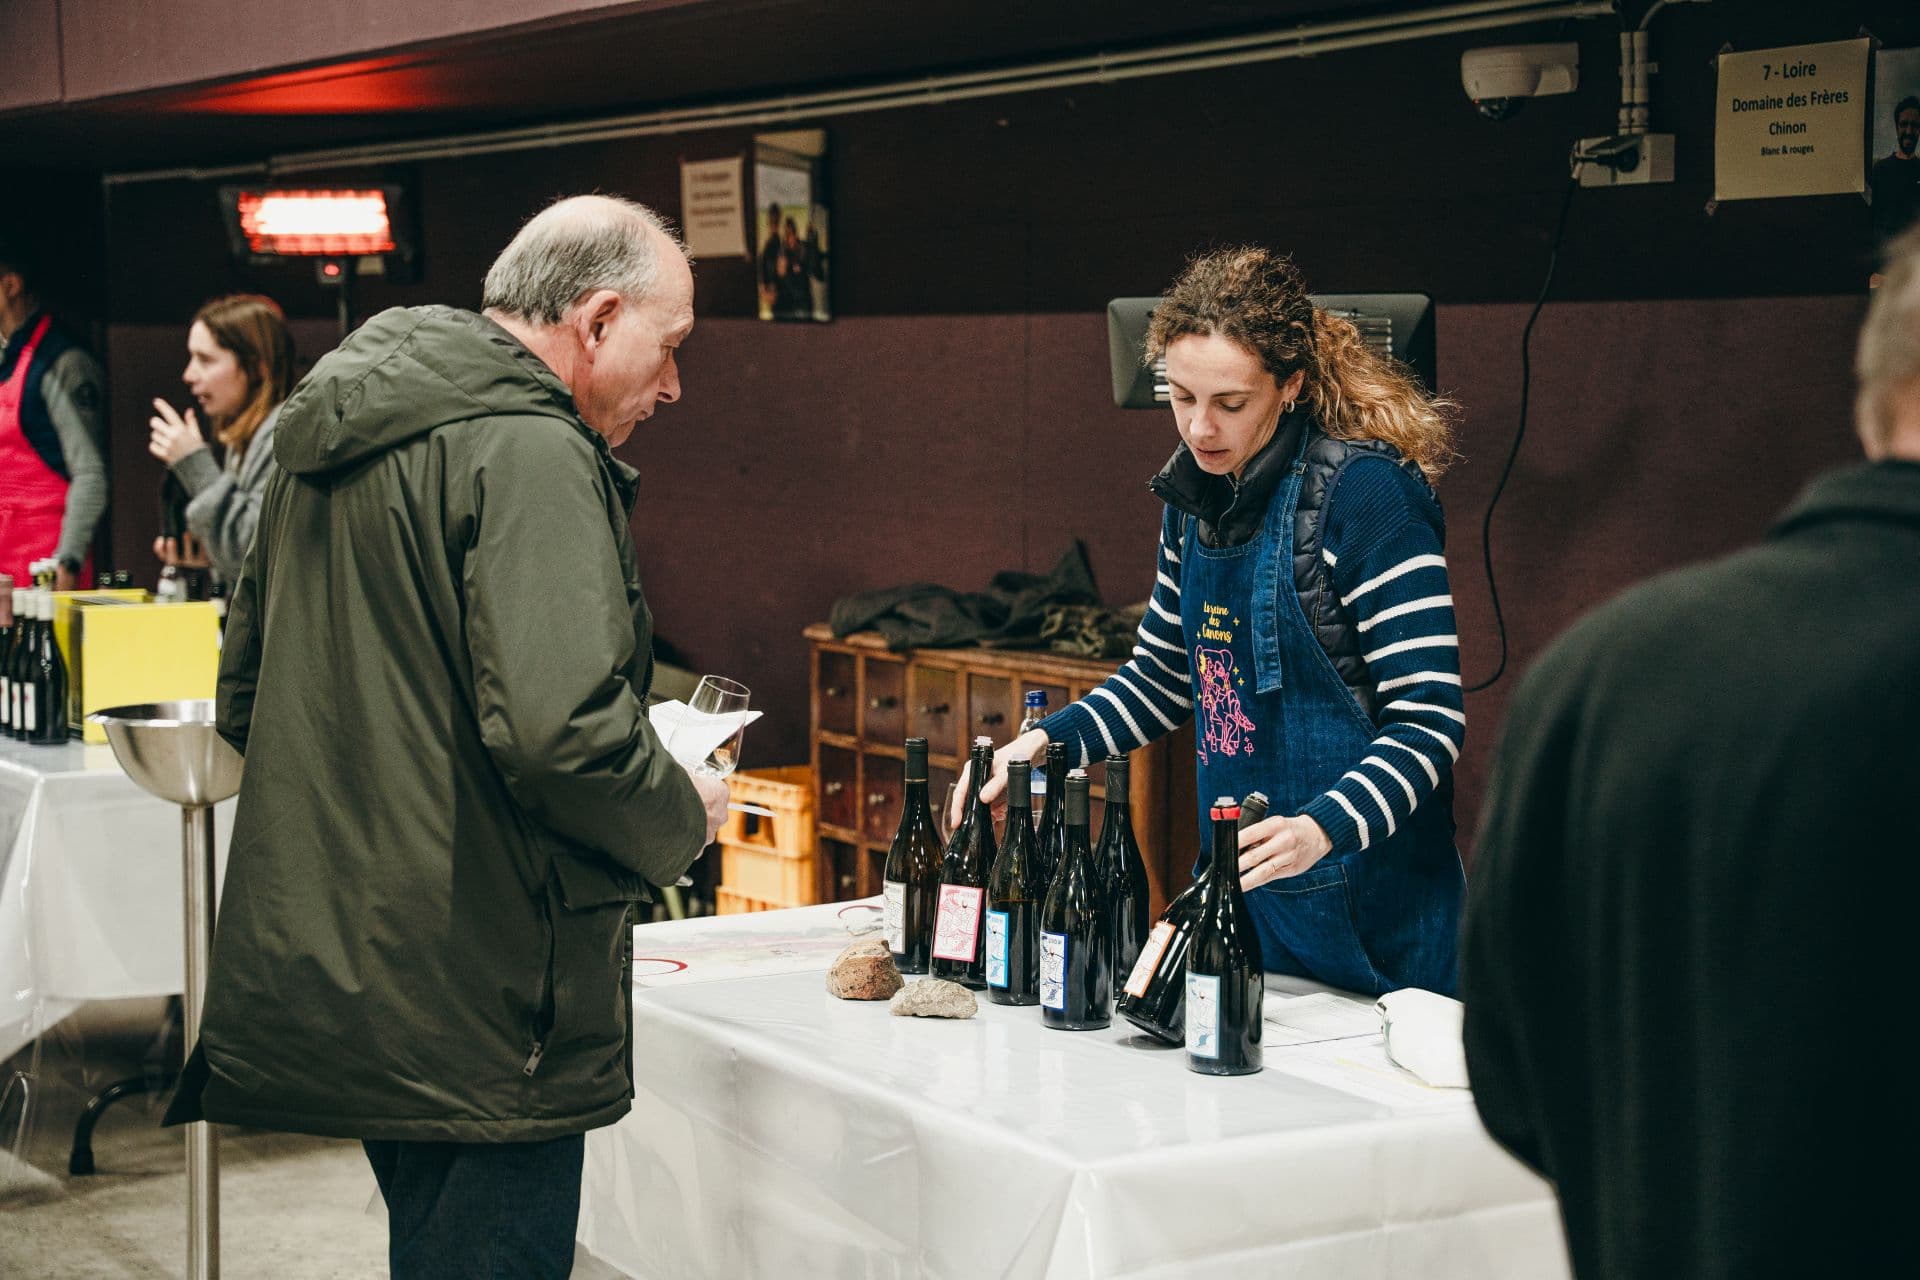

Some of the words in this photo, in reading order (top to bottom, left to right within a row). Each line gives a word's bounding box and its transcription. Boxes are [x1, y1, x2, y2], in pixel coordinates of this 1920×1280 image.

[1763, 64, 1771, 80] 7
[1783, 61, 1817, 79] Loire
[1732, 95, 1783, 112] Domaine
[1787, 93, 1807, 107] des
[1811, 89, 1849, 105] Frères
[1769, 121, 1807, 135] Chinon
[1761, 146, 1780, 156] Blanc
[1782, 145, 1788, 155] &
[1789, 144, 1814, 156] rouges
